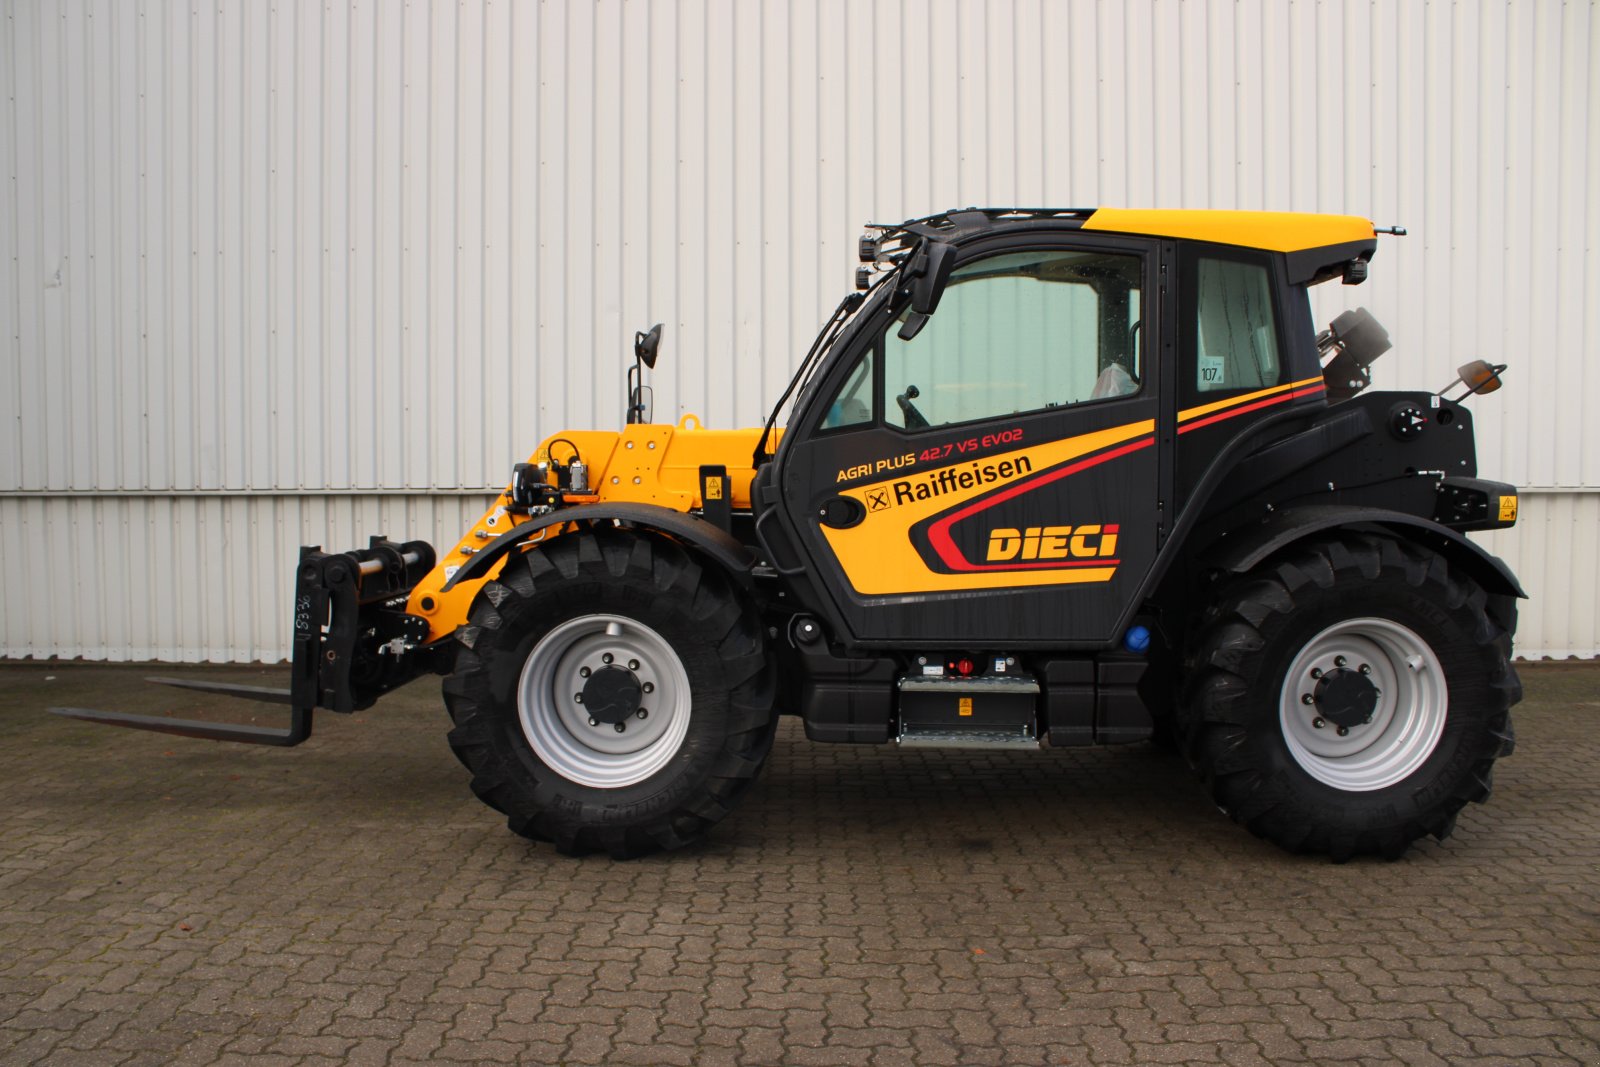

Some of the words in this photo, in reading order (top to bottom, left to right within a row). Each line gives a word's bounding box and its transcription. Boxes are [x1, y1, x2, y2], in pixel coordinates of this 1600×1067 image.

[1201, 367, 1218, 381] 107
[836, 464, 873, 483] AGRI
[876, 453, 916, 473] PLUS
[919, 444, 954, 462] 42.7
[956, 438, 979, 453] VS
[893, 455, 1033, 506] Raiffeisen
